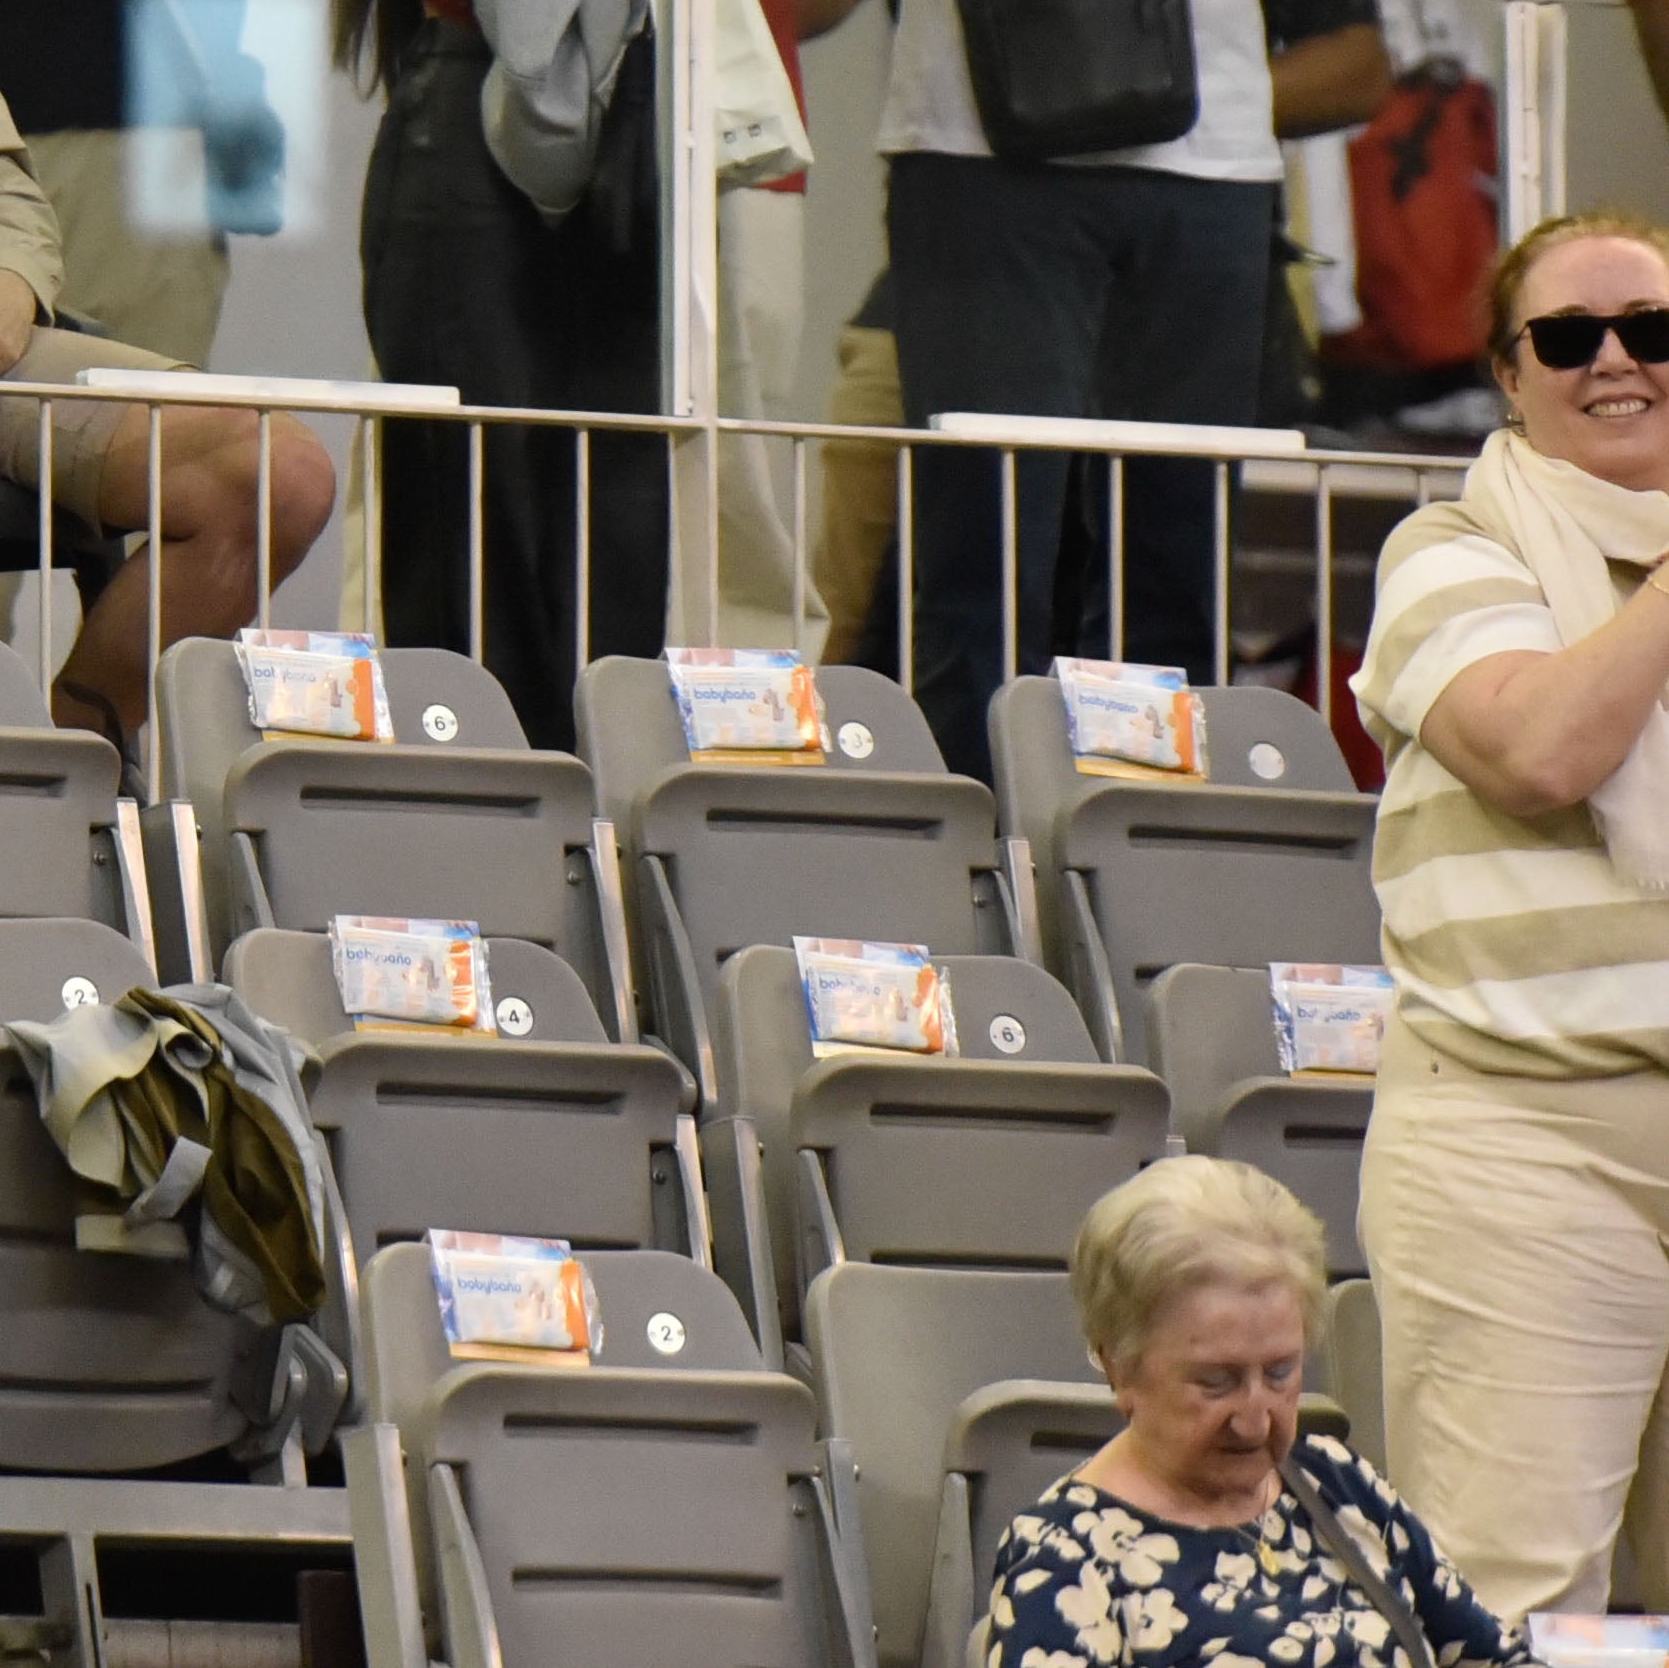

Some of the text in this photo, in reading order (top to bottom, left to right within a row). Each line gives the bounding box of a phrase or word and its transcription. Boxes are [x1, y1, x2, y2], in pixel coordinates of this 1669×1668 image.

[434, 716, 446, 731] 6
[74, 989, 88, 1004] 2
[509, 1009, 520, 1024] 4
[1002, 1027, 1014, 1042] 6
[661, 1325, 673, 1341] 2
